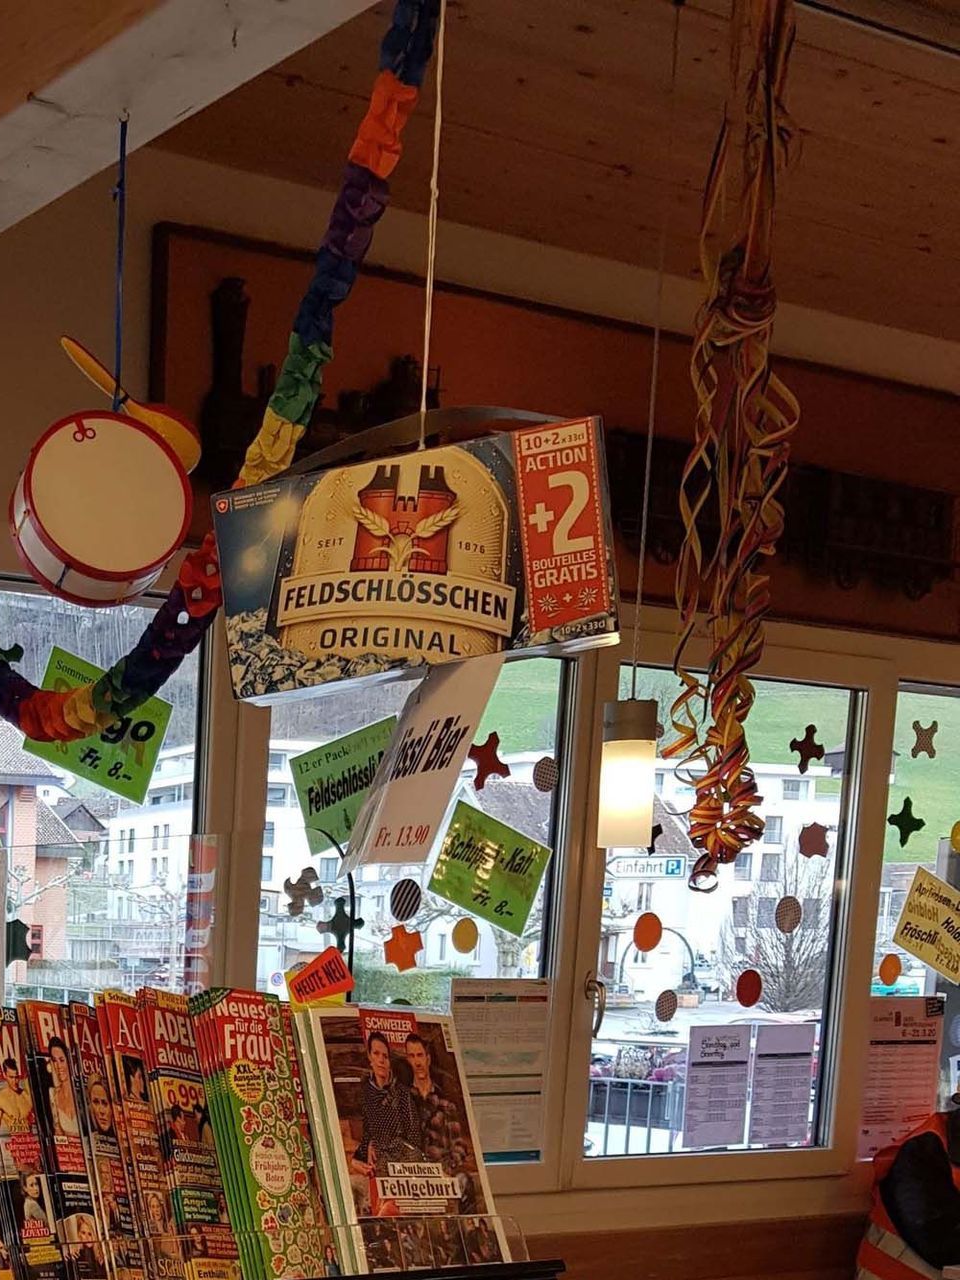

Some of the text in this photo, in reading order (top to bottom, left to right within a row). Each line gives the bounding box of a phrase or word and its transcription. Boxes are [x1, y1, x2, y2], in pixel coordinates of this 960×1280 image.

[526, 447, 587, 472] ACTION
[317, 536, 345, 549] SEIT
[532, 550, 596, 571] BOUTEILLES
[533, 562, 598, 588] GRATIS
[283, 573, 508, 622] FELDSCHLÖSSCHEN
[319, 626, 462, 656] ORIGINAL
[56, 659, 96, 686] Sommer
[100, 716, 157, 744] go
[325, 746, 349, 763] Pack
[395, 825, 431, 848] 13.90
[616, 861, 663, 874] Einfahrt
[294, 954, 347, 999] HEUTE NEU
[215, 998, 266, 1020] Neues
[235, 1018, 263, 1034] für die
[365, 1017, 413, 1033] SCHWEIZER
[224, 1024, 272, 1061] Frau
[392, 1163, 441, 1176] Tabuthema
[379, 1178, 459, 1199] Fehlgeburt
[22, 1228, 50, 1238] LOVATO
